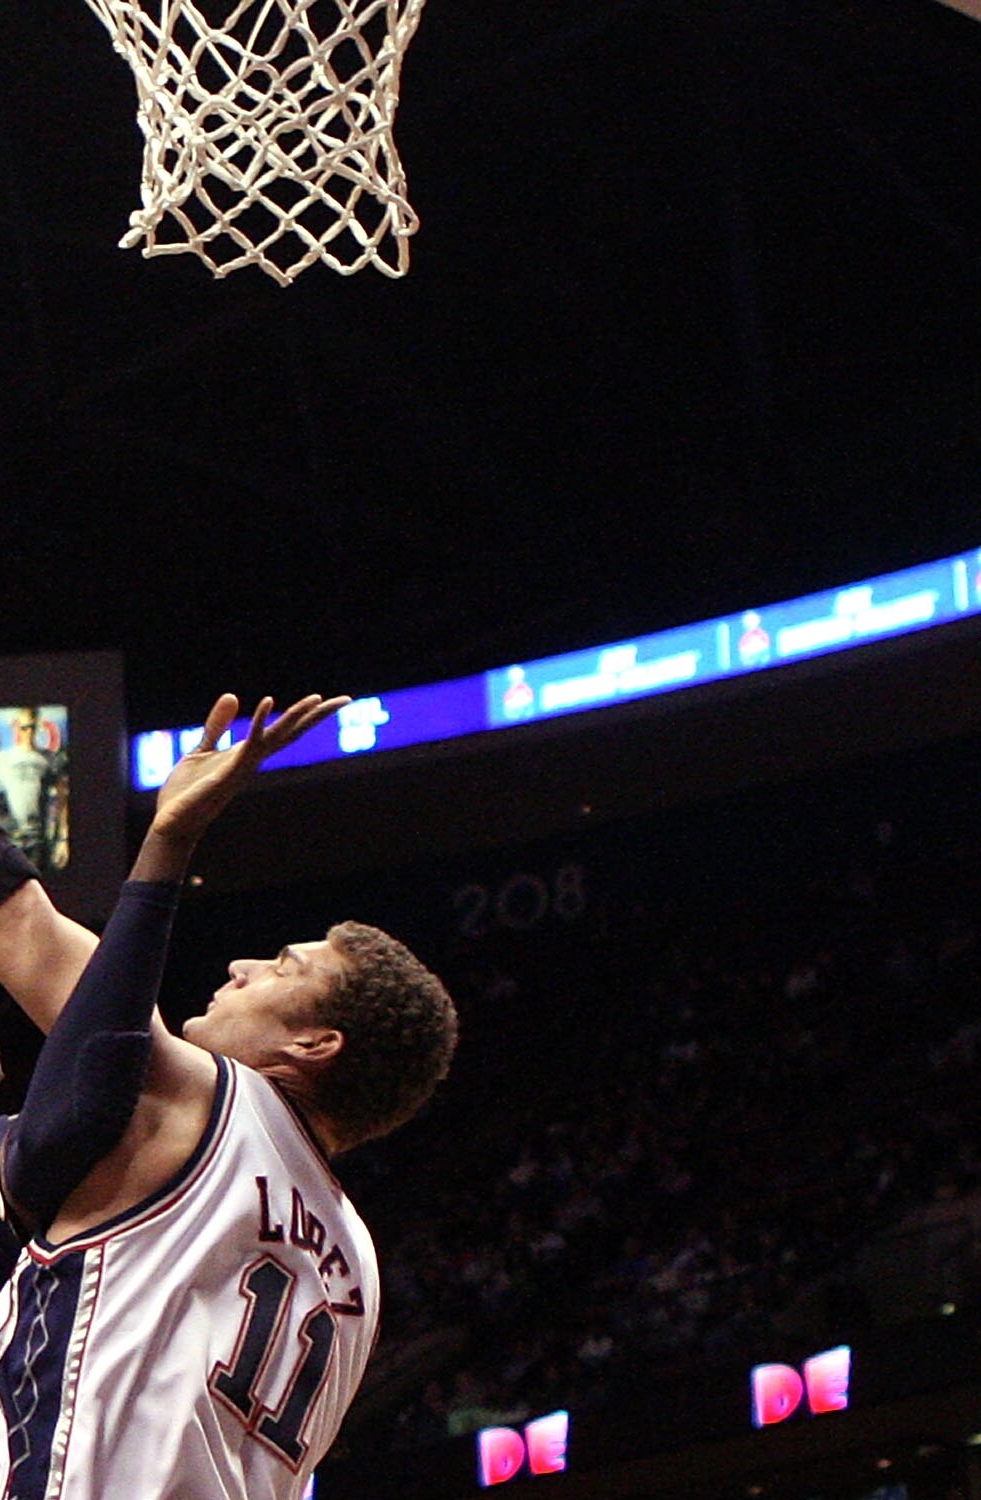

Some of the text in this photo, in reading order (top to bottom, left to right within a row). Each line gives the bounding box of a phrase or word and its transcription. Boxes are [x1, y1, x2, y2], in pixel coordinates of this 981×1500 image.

[454, 864, 588, 938] 208
[207, 1251, 339, 1476] 11
[750, 1345, 851, 1428] DE
[476, 1409, 569, 1487] DE
